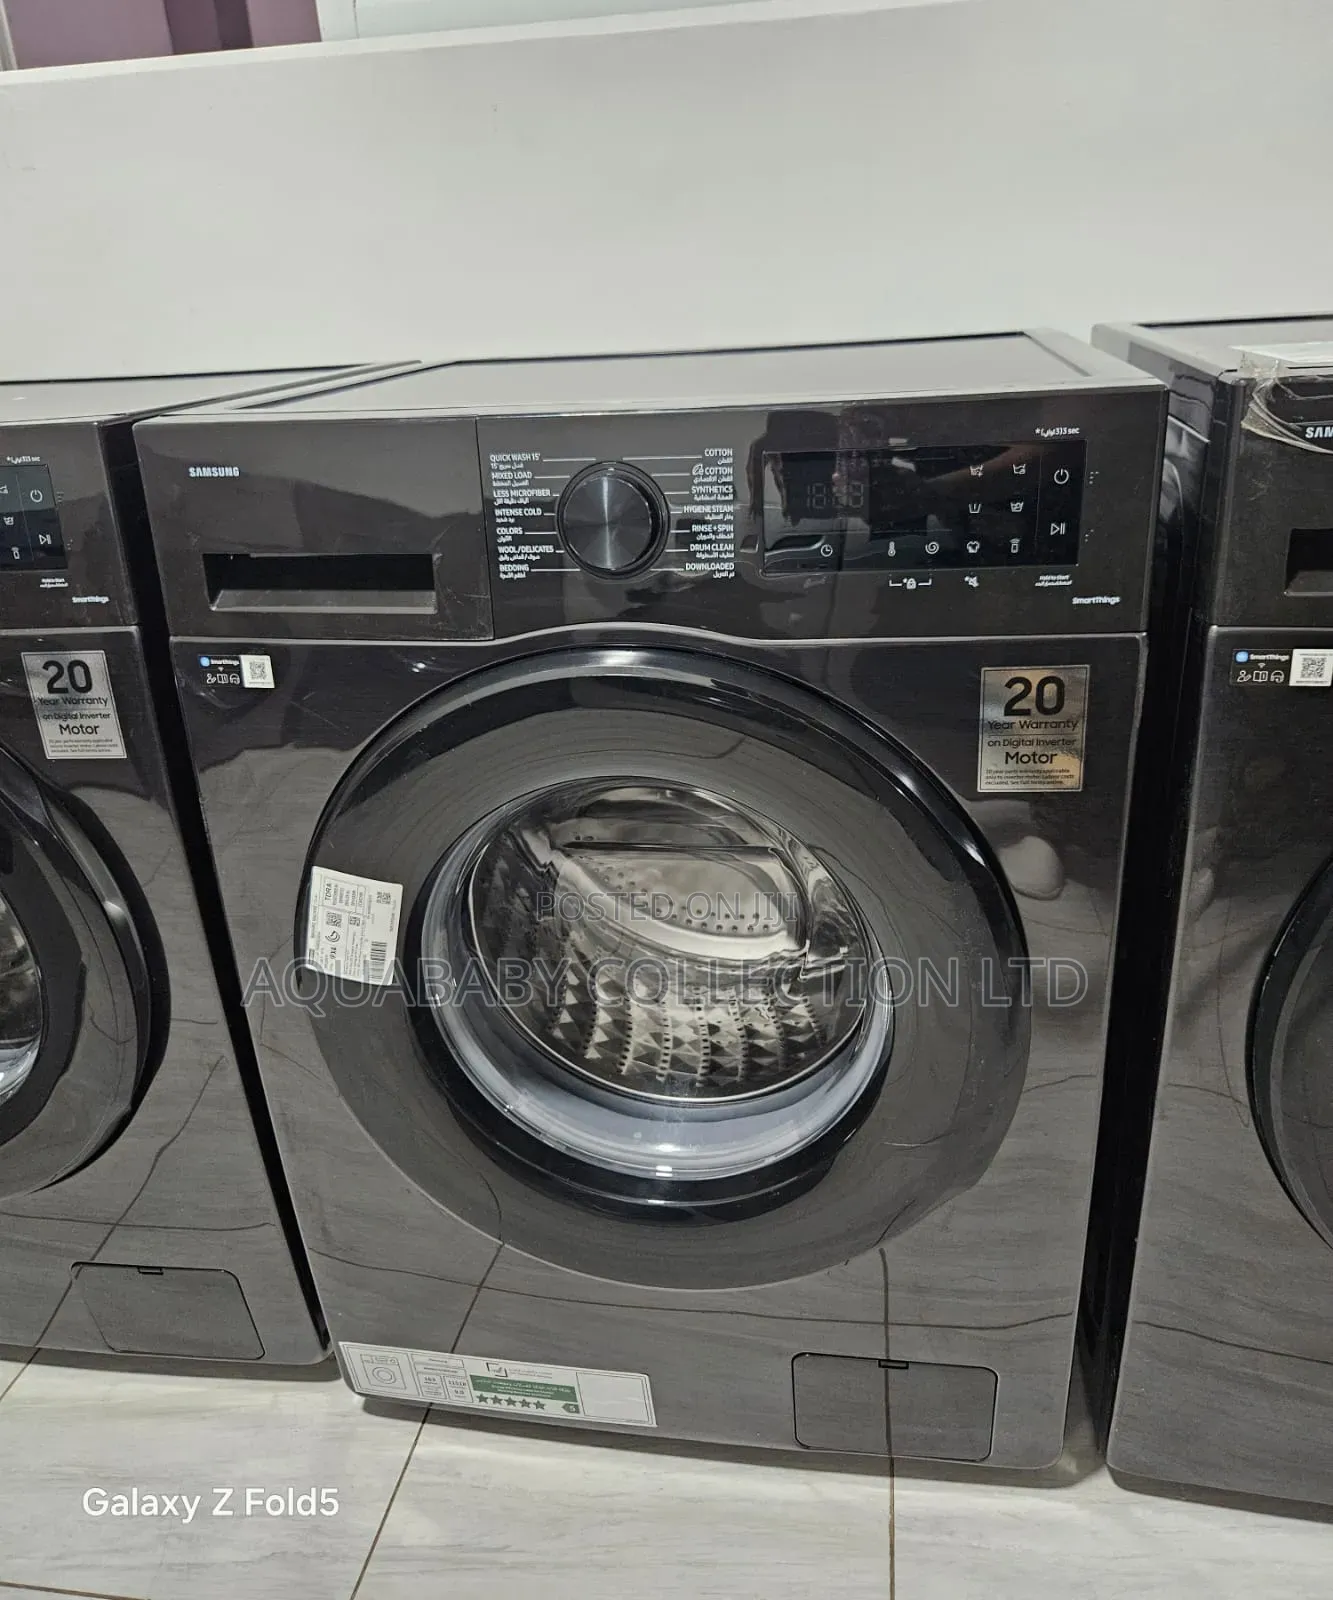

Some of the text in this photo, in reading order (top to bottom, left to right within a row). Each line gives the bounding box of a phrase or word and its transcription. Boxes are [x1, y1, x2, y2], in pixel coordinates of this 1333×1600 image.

[489, 454, 511, 462] QUICK
[511, 452, 530, 461] WASH
[704, 447, 733, 457] COTTON
[188, 466, 240, 478] SAMSUNG
[491, 471, 533, 480] MIXED LOAD
[704, 466, 733, 476] COTTON
[493, 487, 551, 498] LESS MICROFIBER
[691, 485, 733, 494] SYNTHETICS
[495, 506, 542, 516] INTENSE COLD
[683, 504, 734, 513] HYGIENE STEAM
[496, 526, 523, 535] COLORS
[691, 523, 713, 533] RINSE
[717, 523, 734, 533] SPIN
[497, 545, 555, 553] WOOL/DELICATES
[690, 543, 735, 552] DRUM CLEAN
[499, 563, 530, 572] BEDDING
[685, 562, 735, 571] DOWNLOADED
[1072, 595, 1121, 605] SmartThings
[42, 660, 92, 694] 20
[1003, 675, 1065, 717] 20
[38, 697, 108, 707] Year Warranty
[54, 713, 78, 722] Digital
[59, 723, 100, 735] Motor
[988, 719, 1079, 731] Year Warranty
[1002, 738, 1034, 749] Digital
[1036, 738, 1076, 747] Inverter
[1004, 751, 1058, 765] Motor
